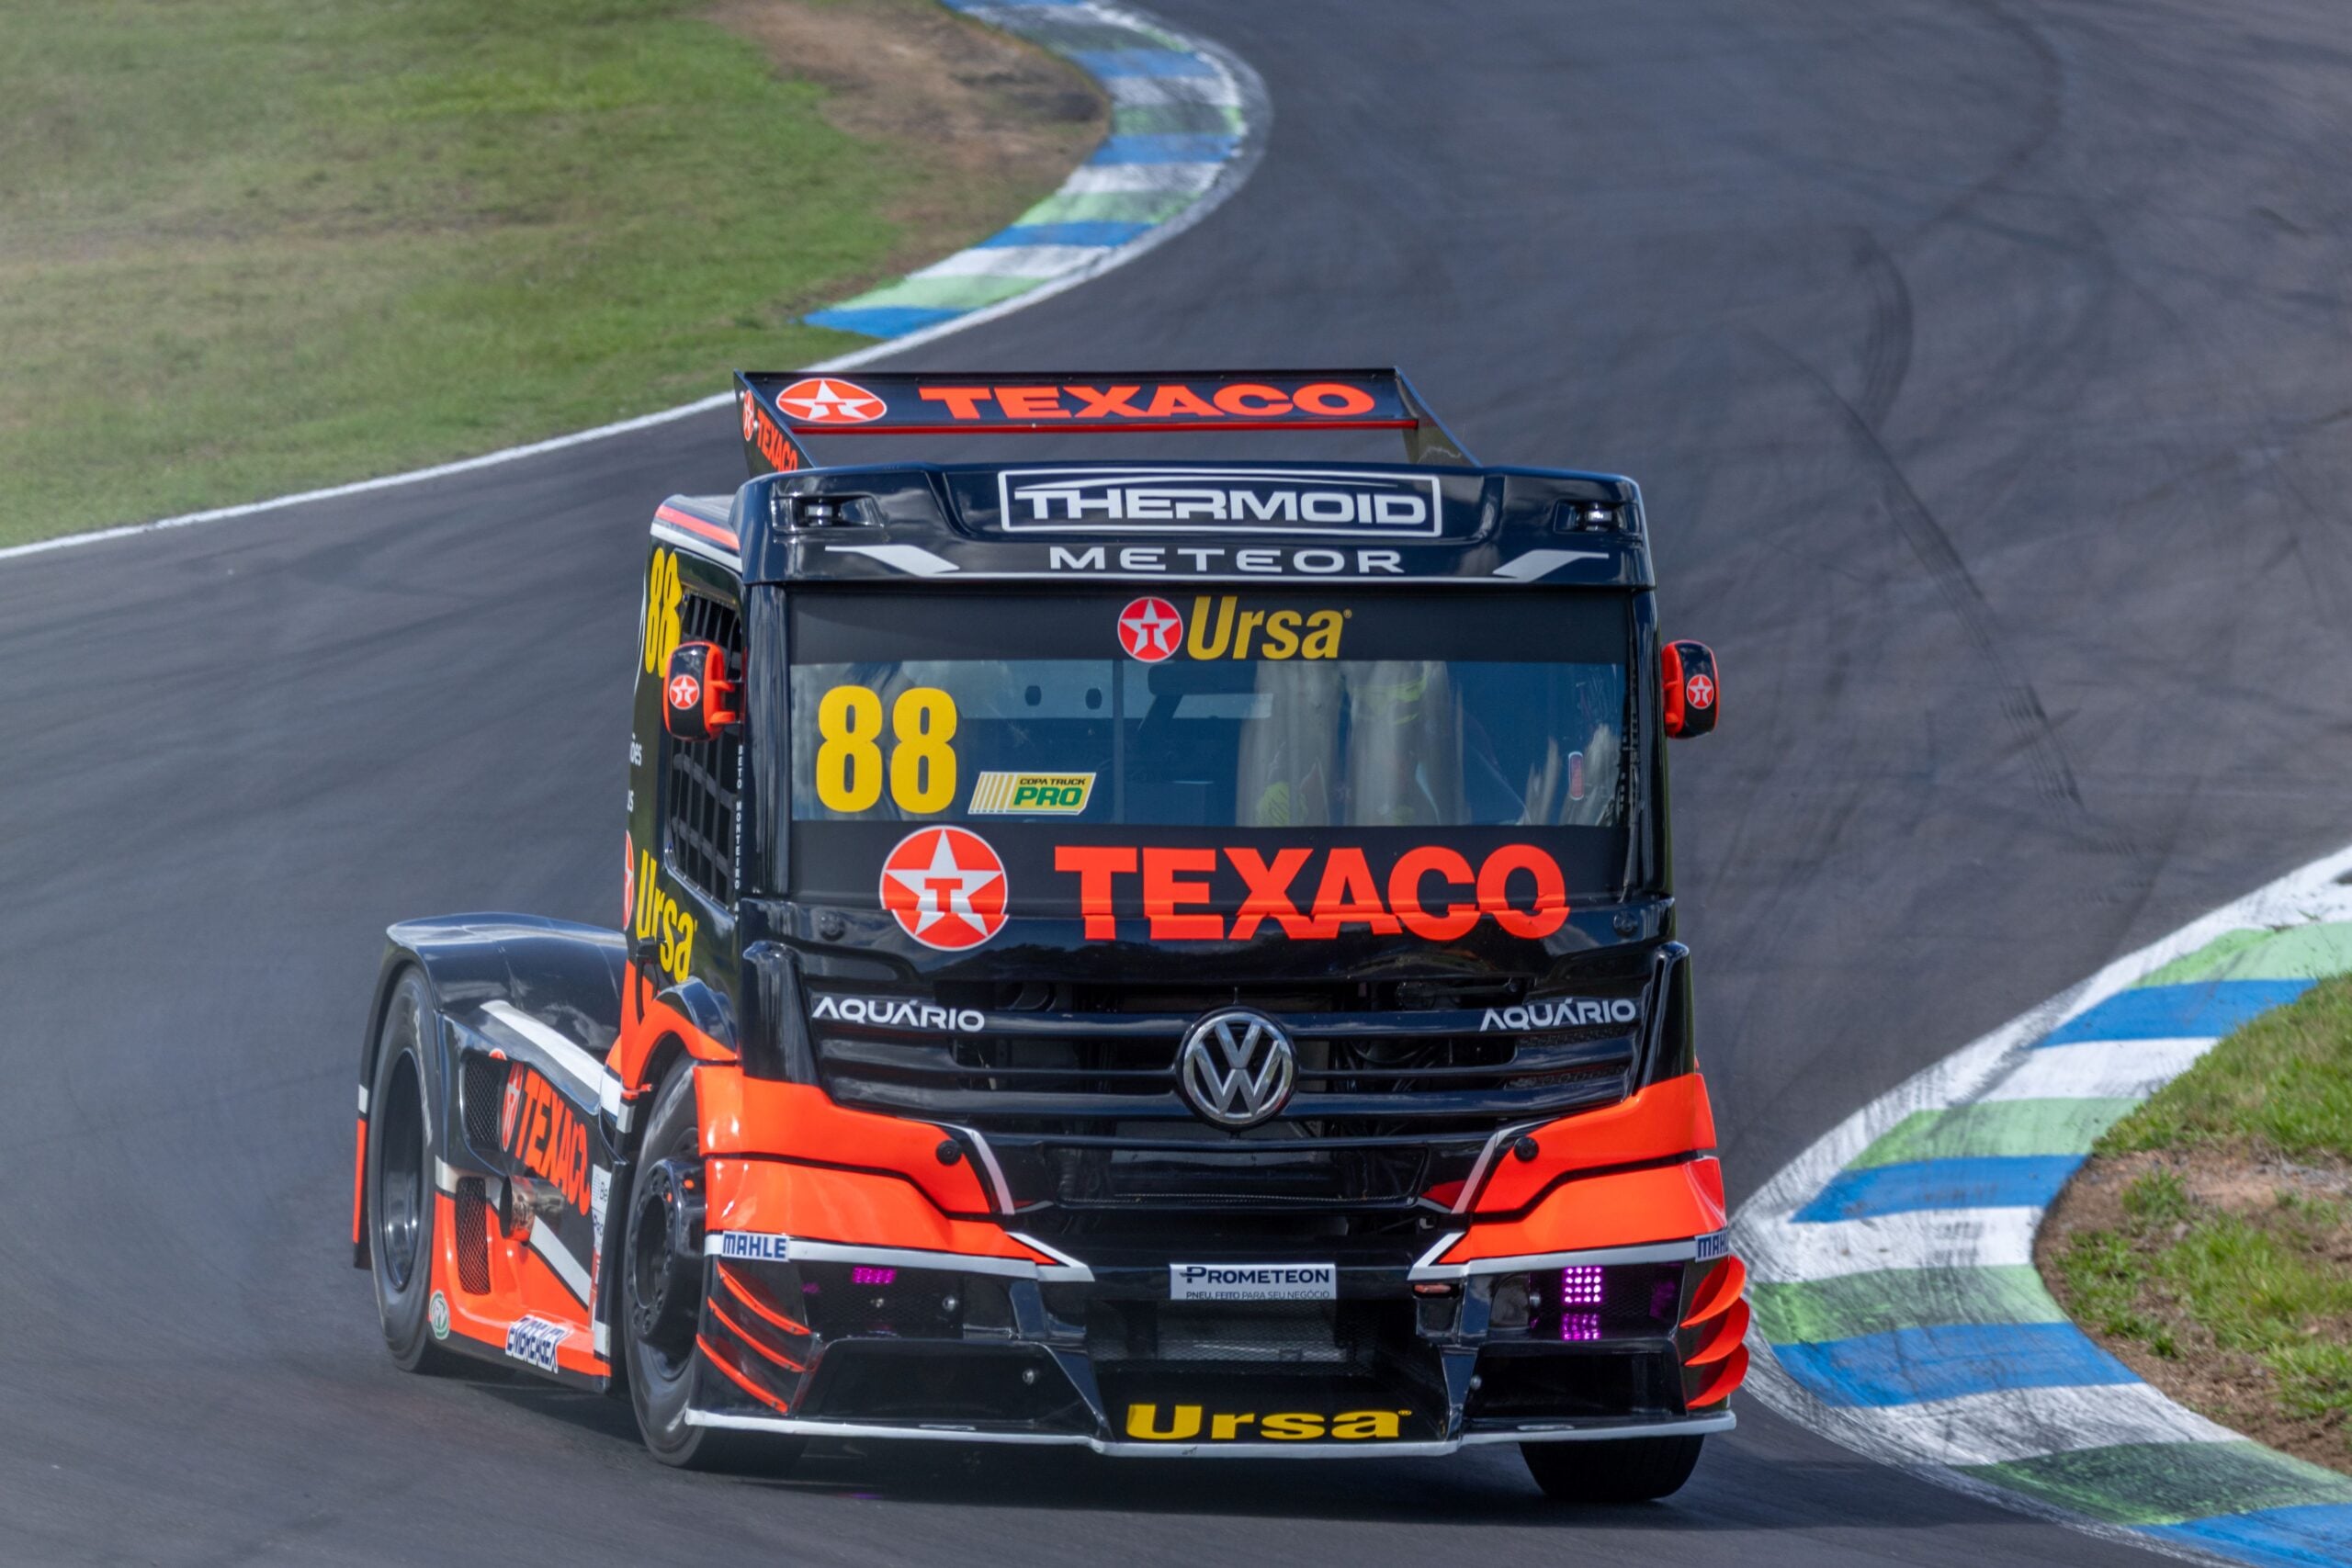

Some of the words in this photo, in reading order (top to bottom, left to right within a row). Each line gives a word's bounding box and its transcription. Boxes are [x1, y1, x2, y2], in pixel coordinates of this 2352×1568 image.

[919, 383, 1375, 420] TEXACO
[1014, 489, 1426, 525] THERMOID
[1049, 547, 1405, 573] METEOR
[815, 685, 957, 815] 88
[1013, 786, 1082, 807] PRO
[734, 801, 742, 890] MONTEIRO
[1055, 843, 1570, 942] TEXACO
[811, 996, 986, 1032] AQUÁRIO
[1479, 998, 1636, 1032] AQUÁRIO
[723, 1234, 787, 1259] MAHLE
[1180, 1266, 1329, 1284] PROMETEON
[1241, 1291, 1265, 1300] PARA
[1268, 1290, 1286, 1300] SEU
[1287, 1289, 1330, 1300] NEGÓCIO
